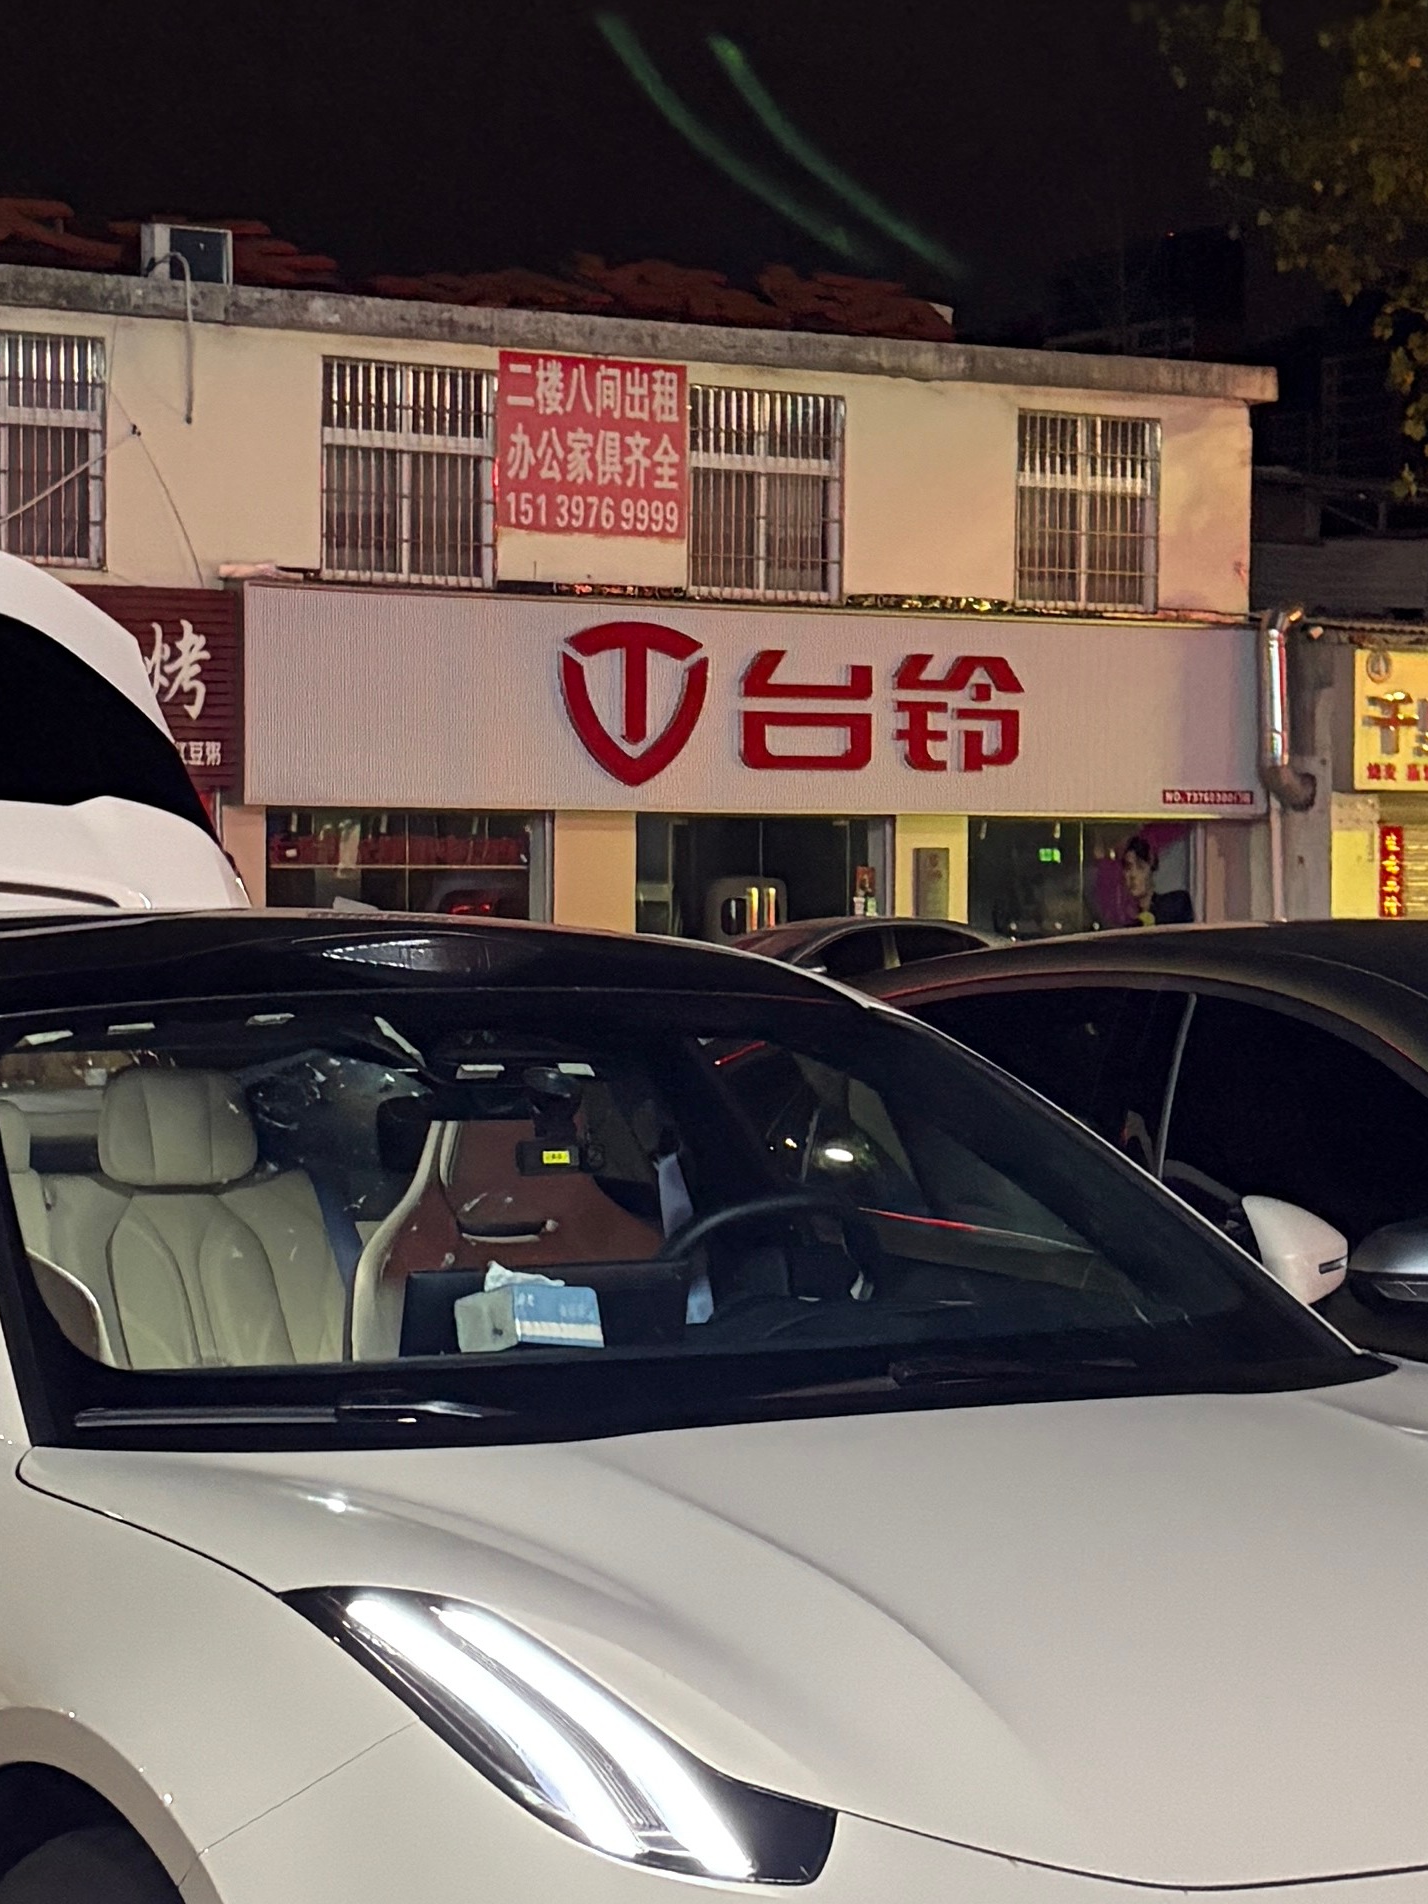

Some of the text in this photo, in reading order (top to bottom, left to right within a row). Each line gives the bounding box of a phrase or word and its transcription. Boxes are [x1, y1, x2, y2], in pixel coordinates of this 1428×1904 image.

[507, 358, 679, 422] 二楼八间出租
[507, 422, 680, 489] 办公家俱齐全
[144, 619, 212, 720] 烤
[740, 649, 1026, 771] 台铃
